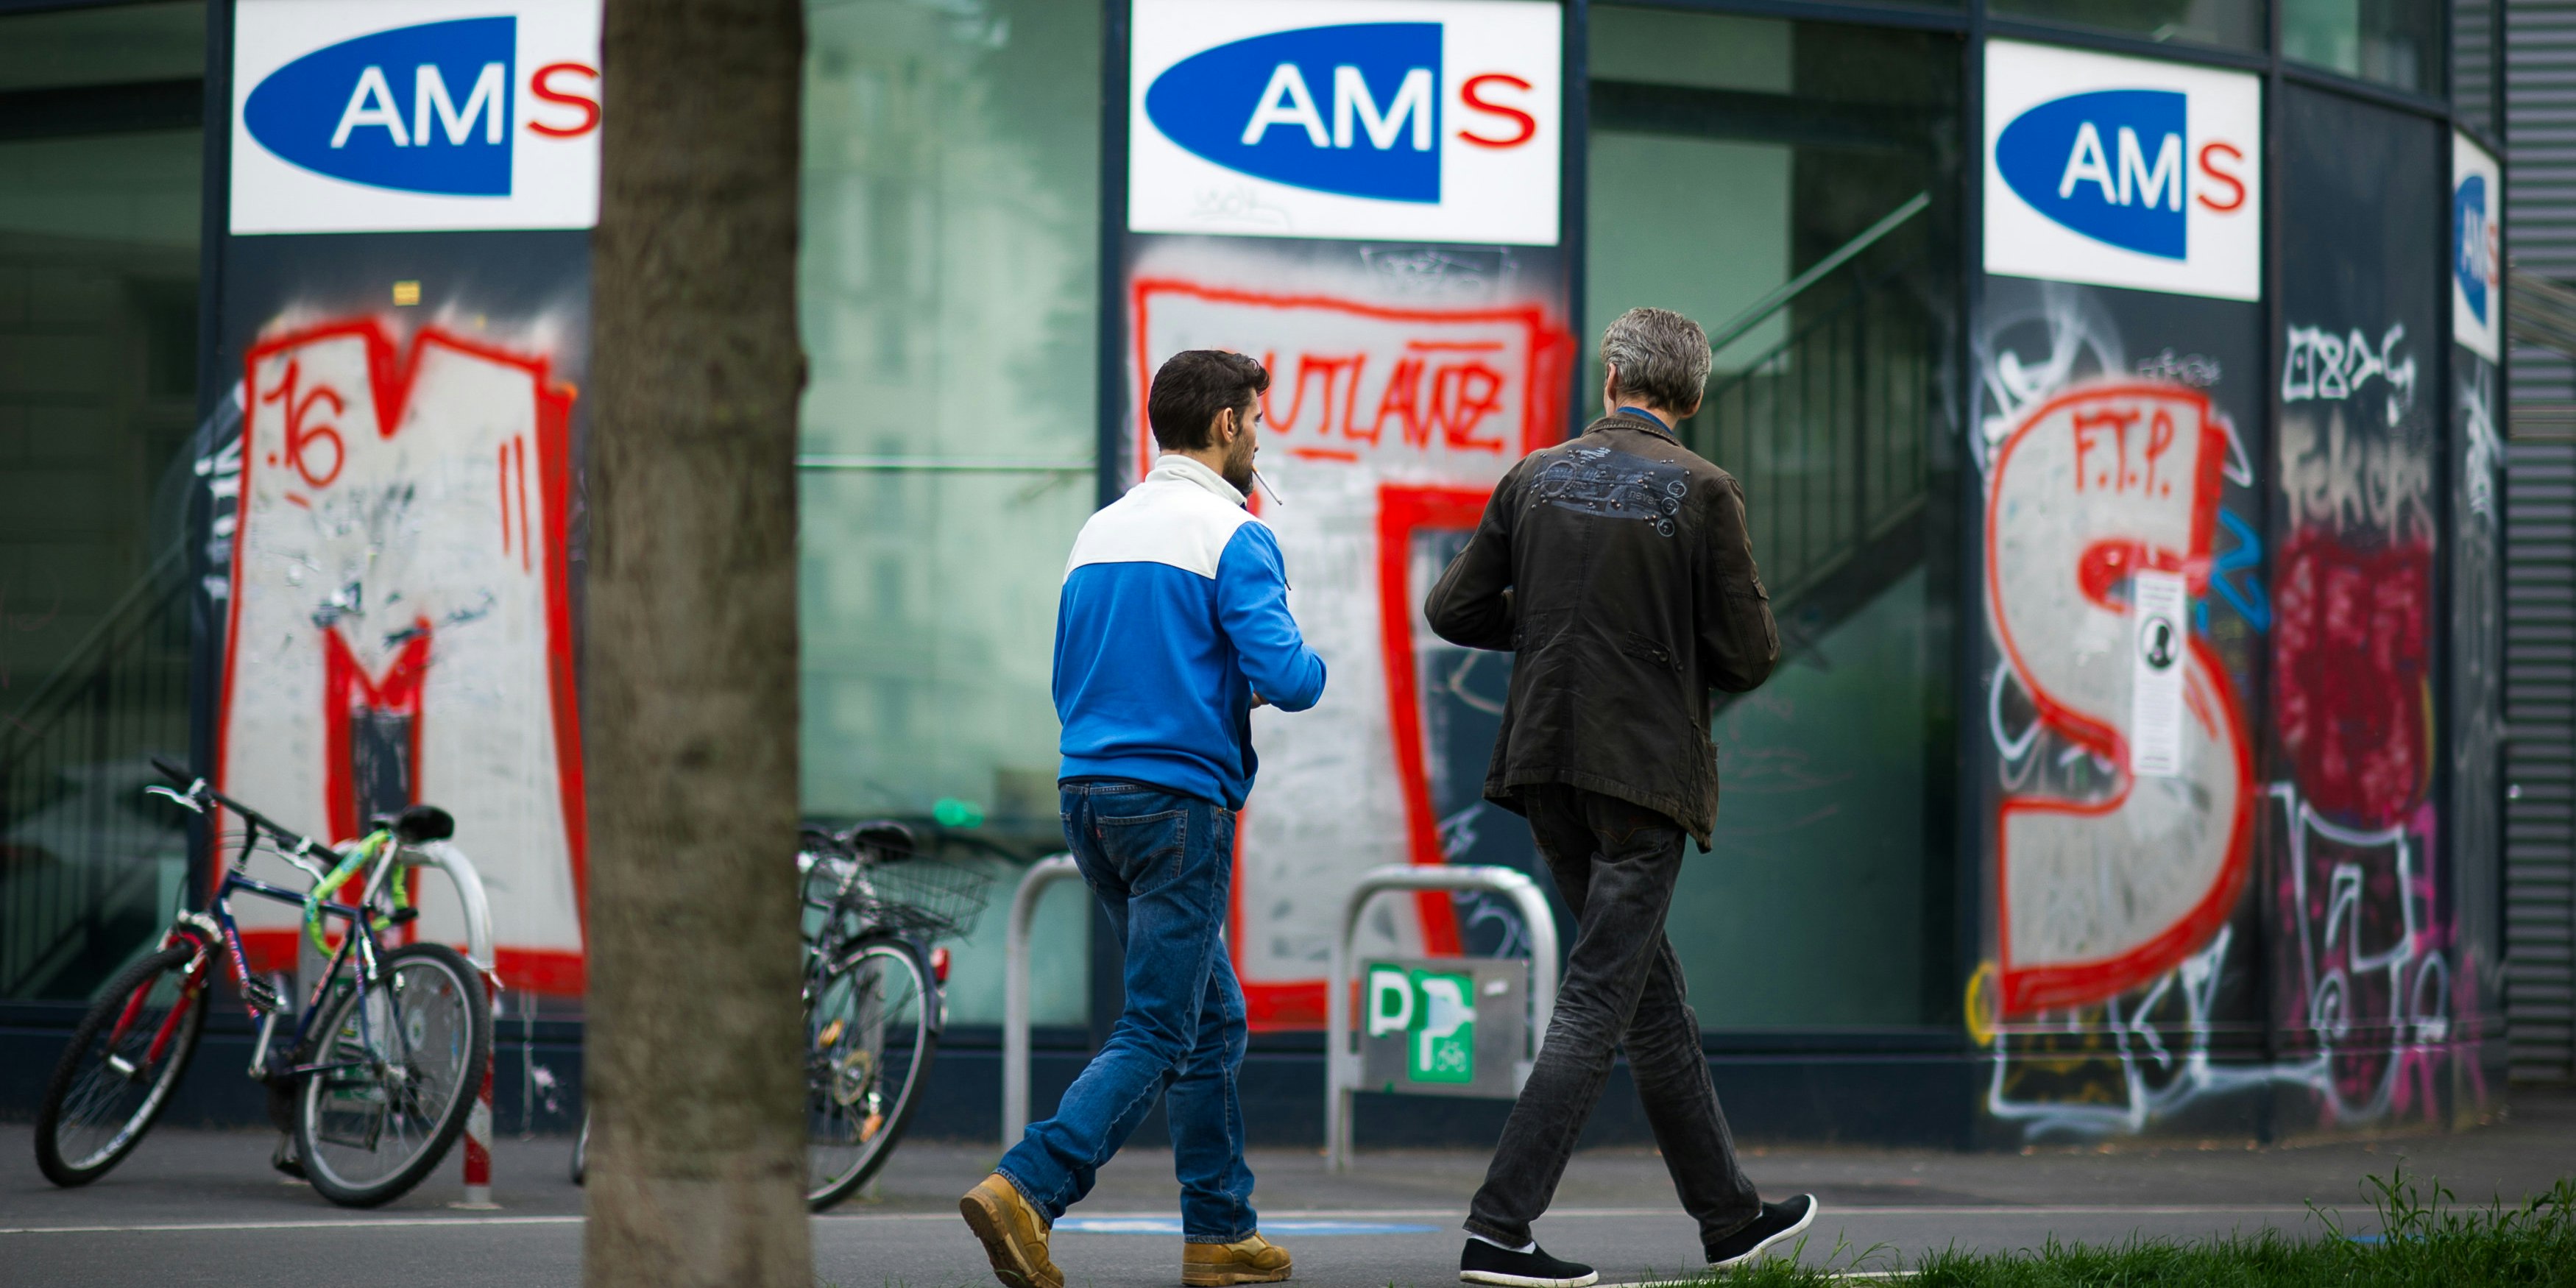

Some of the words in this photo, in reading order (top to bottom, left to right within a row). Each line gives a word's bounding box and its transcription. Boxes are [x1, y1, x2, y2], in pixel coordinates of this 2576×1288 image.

[330, 62, 601, 148] AMS
[1241, 63, 1537, 151] AMS
[2059, 121, 2247, 213] AMS
[2461, 205, 2499, 288] AMS
